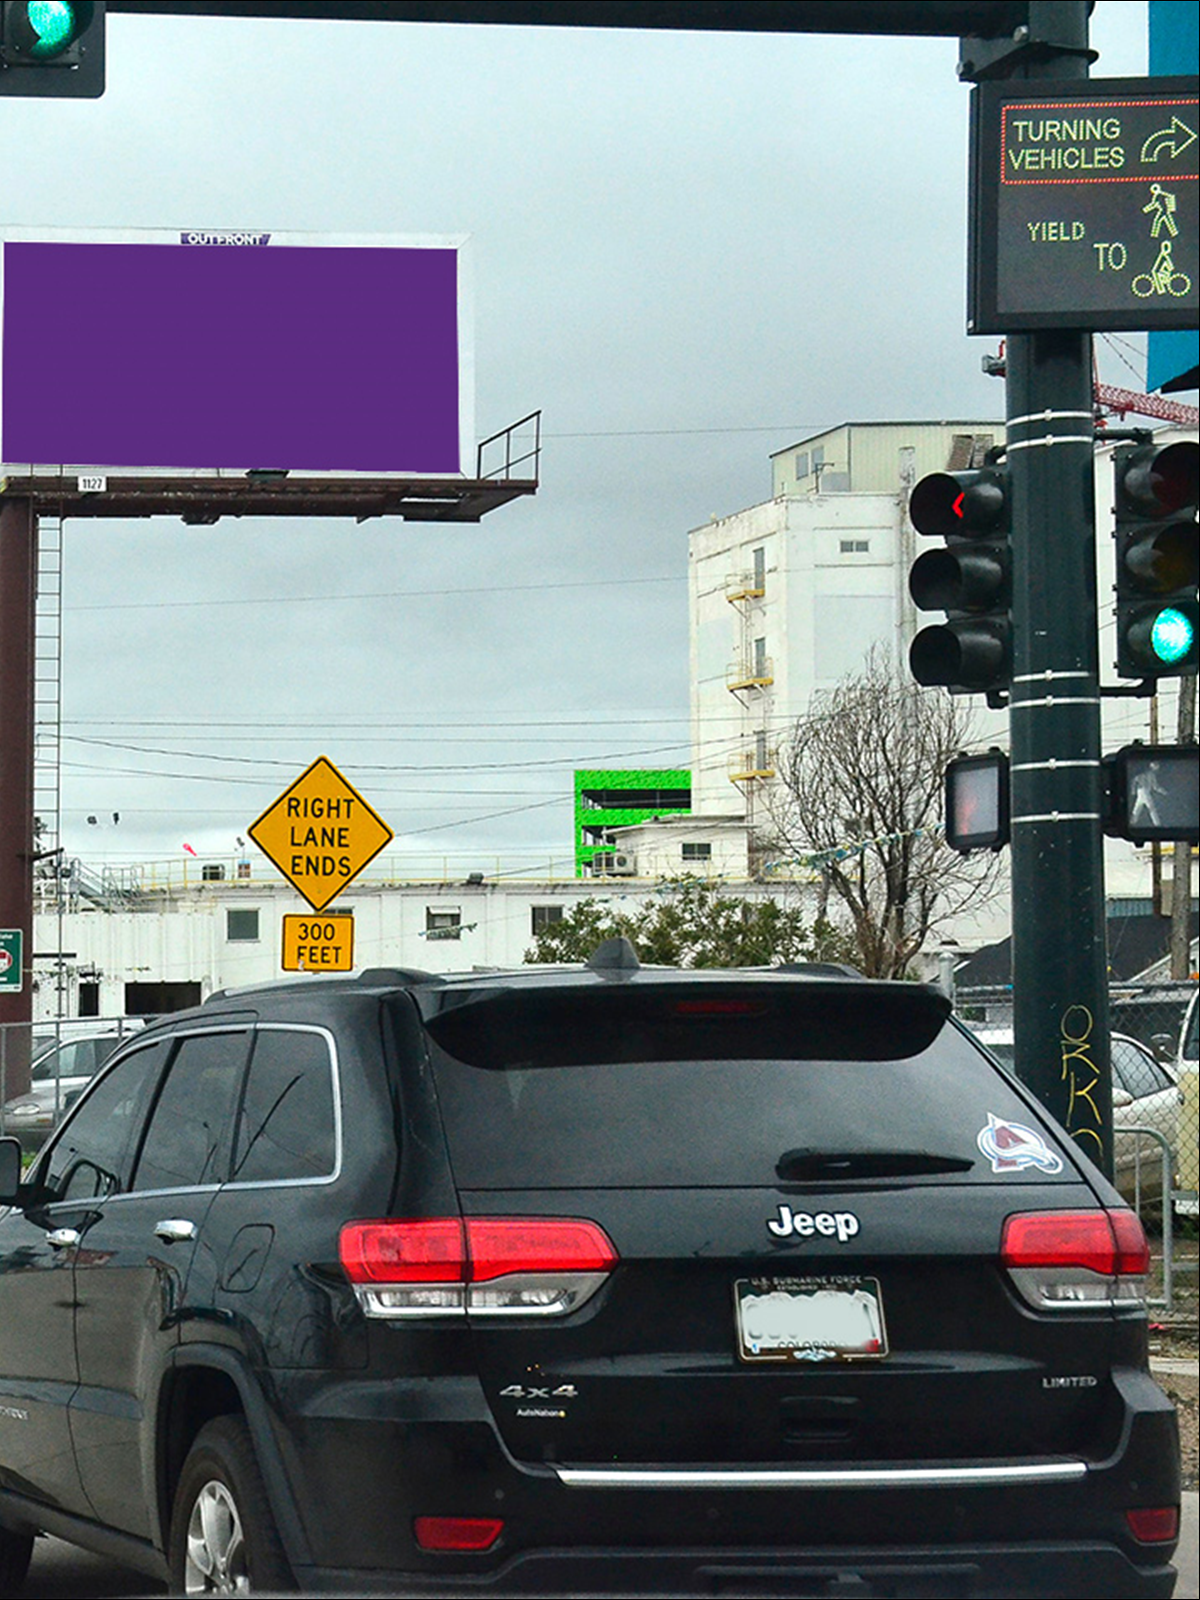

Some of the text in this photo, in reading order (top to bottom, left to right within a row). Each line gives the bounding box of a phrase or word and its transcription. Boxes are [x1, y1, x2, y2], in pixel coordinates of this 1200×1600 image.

[1012, 118, 1121, 142] TURNING
[1008, 146, 1125, 170] VEHICLES
[187, 232, 262, 246] OUTFRONT
[1027, 221, 1085, 241] YIELD
[1093, 242, 1127, 270] TO
[82, 477, 103, 490] 1127
[287, 797, 354, 818] RIGHT
[290, 826, 350, 848] LANE
[291, 855, 351, 877] ENDS
[298, 923, 335, 941] 300
[297, 946, 342, 964] FEET
[767, 1205, 860, 1243] Jeep
[1042, 1375, 1098, 1388] LIMITED
